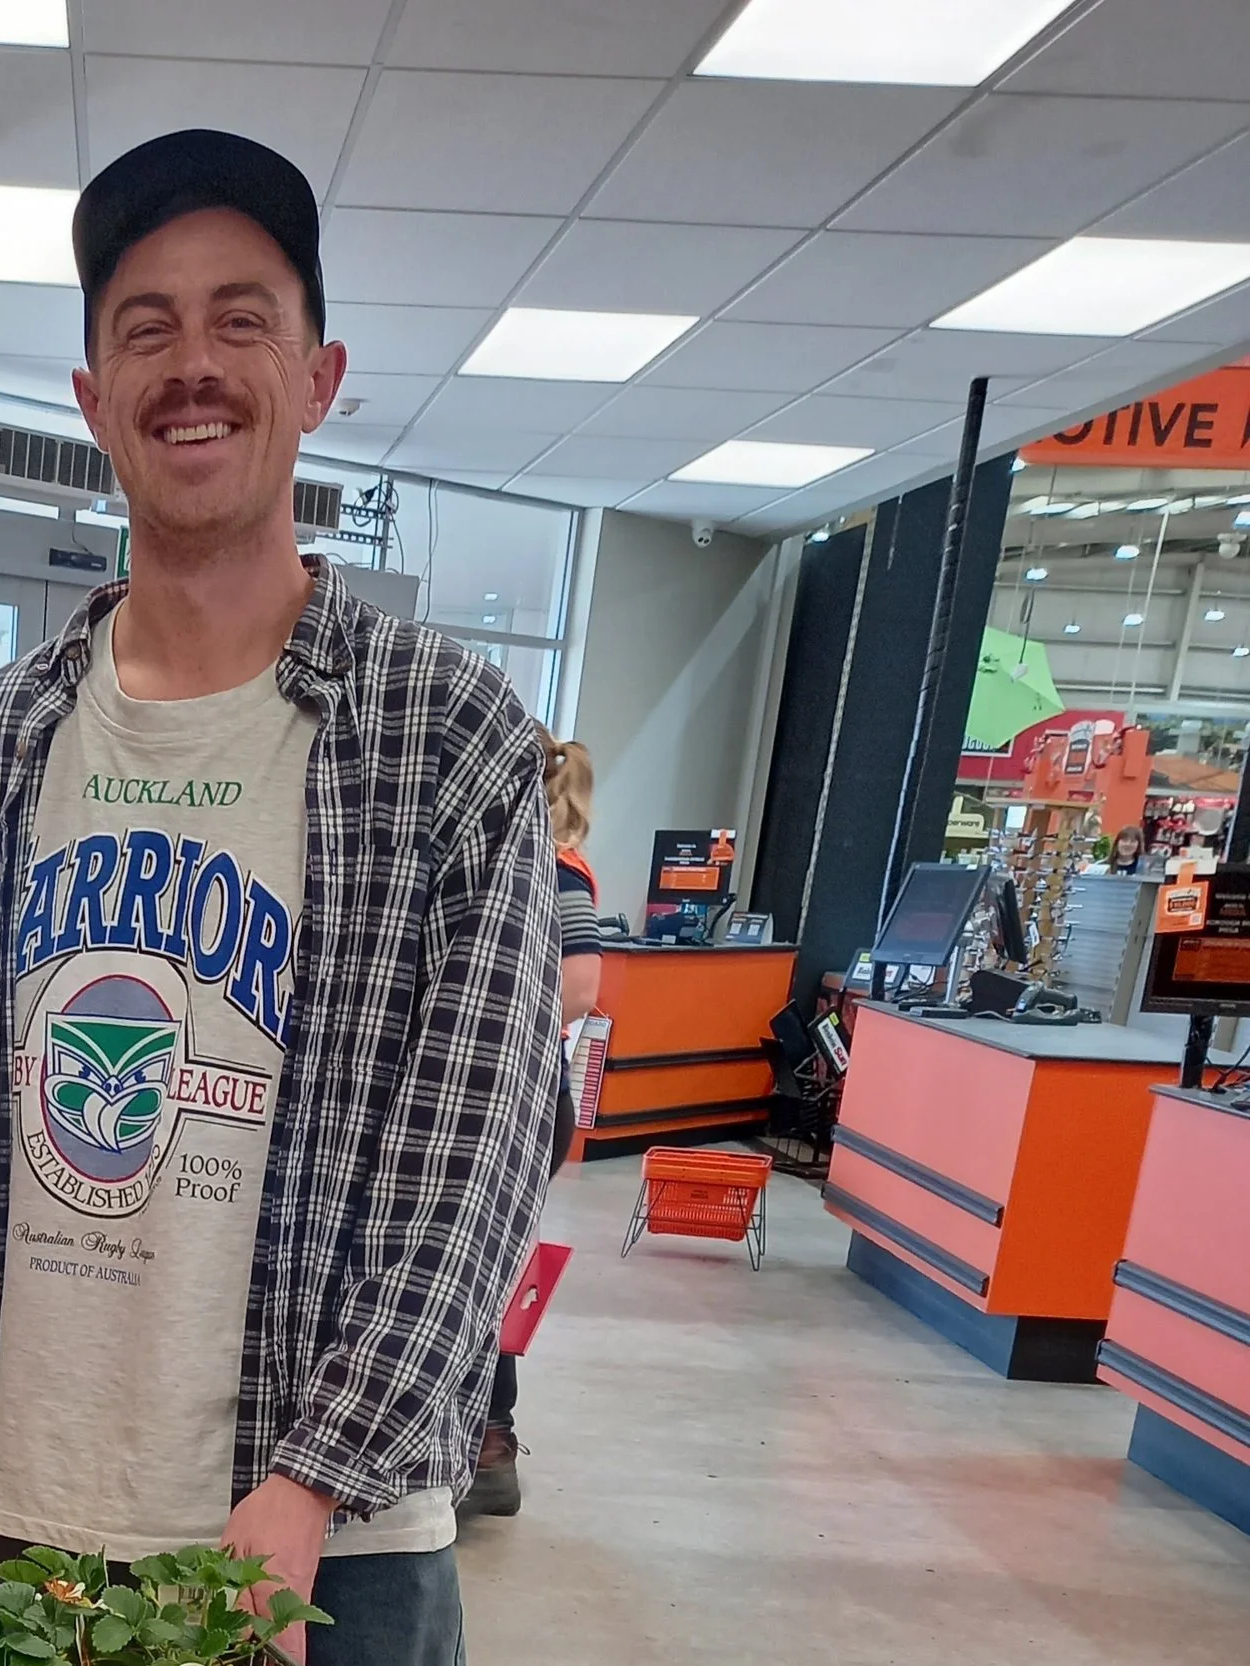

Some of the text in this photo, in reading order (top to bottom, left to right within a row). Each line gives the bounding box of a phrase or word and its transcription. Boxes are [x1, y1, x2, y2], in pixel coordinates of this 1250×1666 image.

[83, 774, 243, 808] AUCKLAND
[16, 828, 296, 1050] ARRIOR
[166, 1066, 267, 1115] LEAGUE
[26, 1129, 144, 1209] ESTABLISHED
[179, 1153, 243, 1181] 100%
[175, 1177, 241, 1204] Proof
[12, 1222, 74, 1247] Australian
[81, 1231, 126, 1260] Rugby
[29, 1256, 78, 1276] PRODUCT
[80, 1264, 94, 1278] OF
